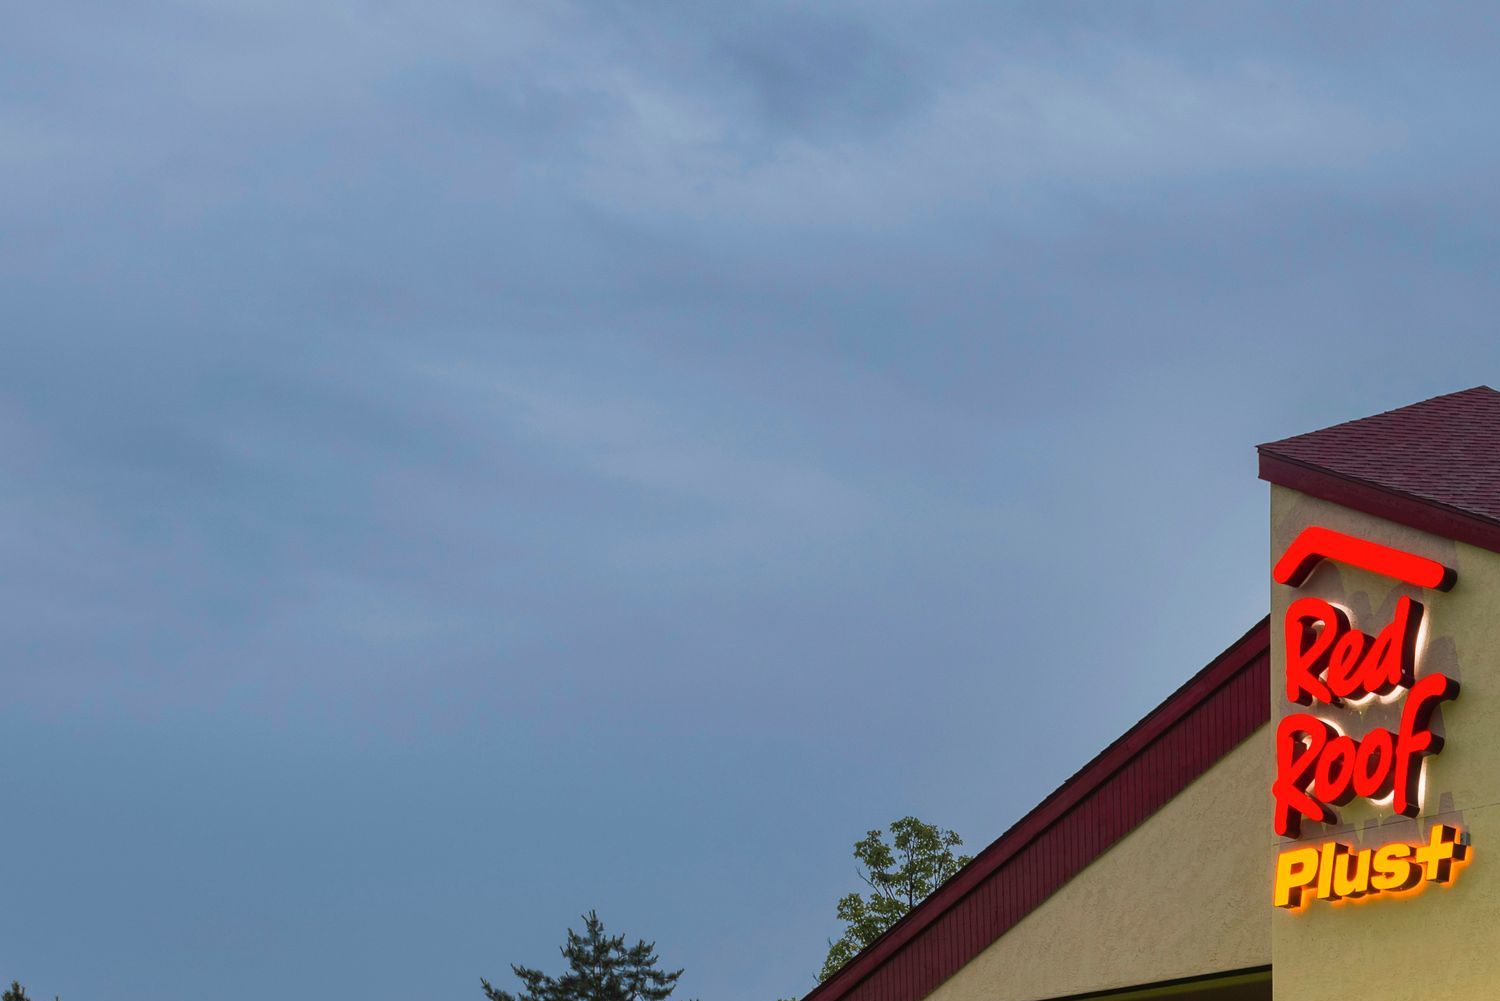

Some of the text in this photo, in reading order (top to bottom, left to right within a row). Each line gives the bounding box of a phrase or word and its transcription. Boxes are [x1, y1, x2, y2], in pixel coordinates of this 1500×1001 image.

[1284, 595, 1413, 705] Red
[1271, 672, 1449, 837] Roof
[1274, 823, 1456, 908] Plus+
